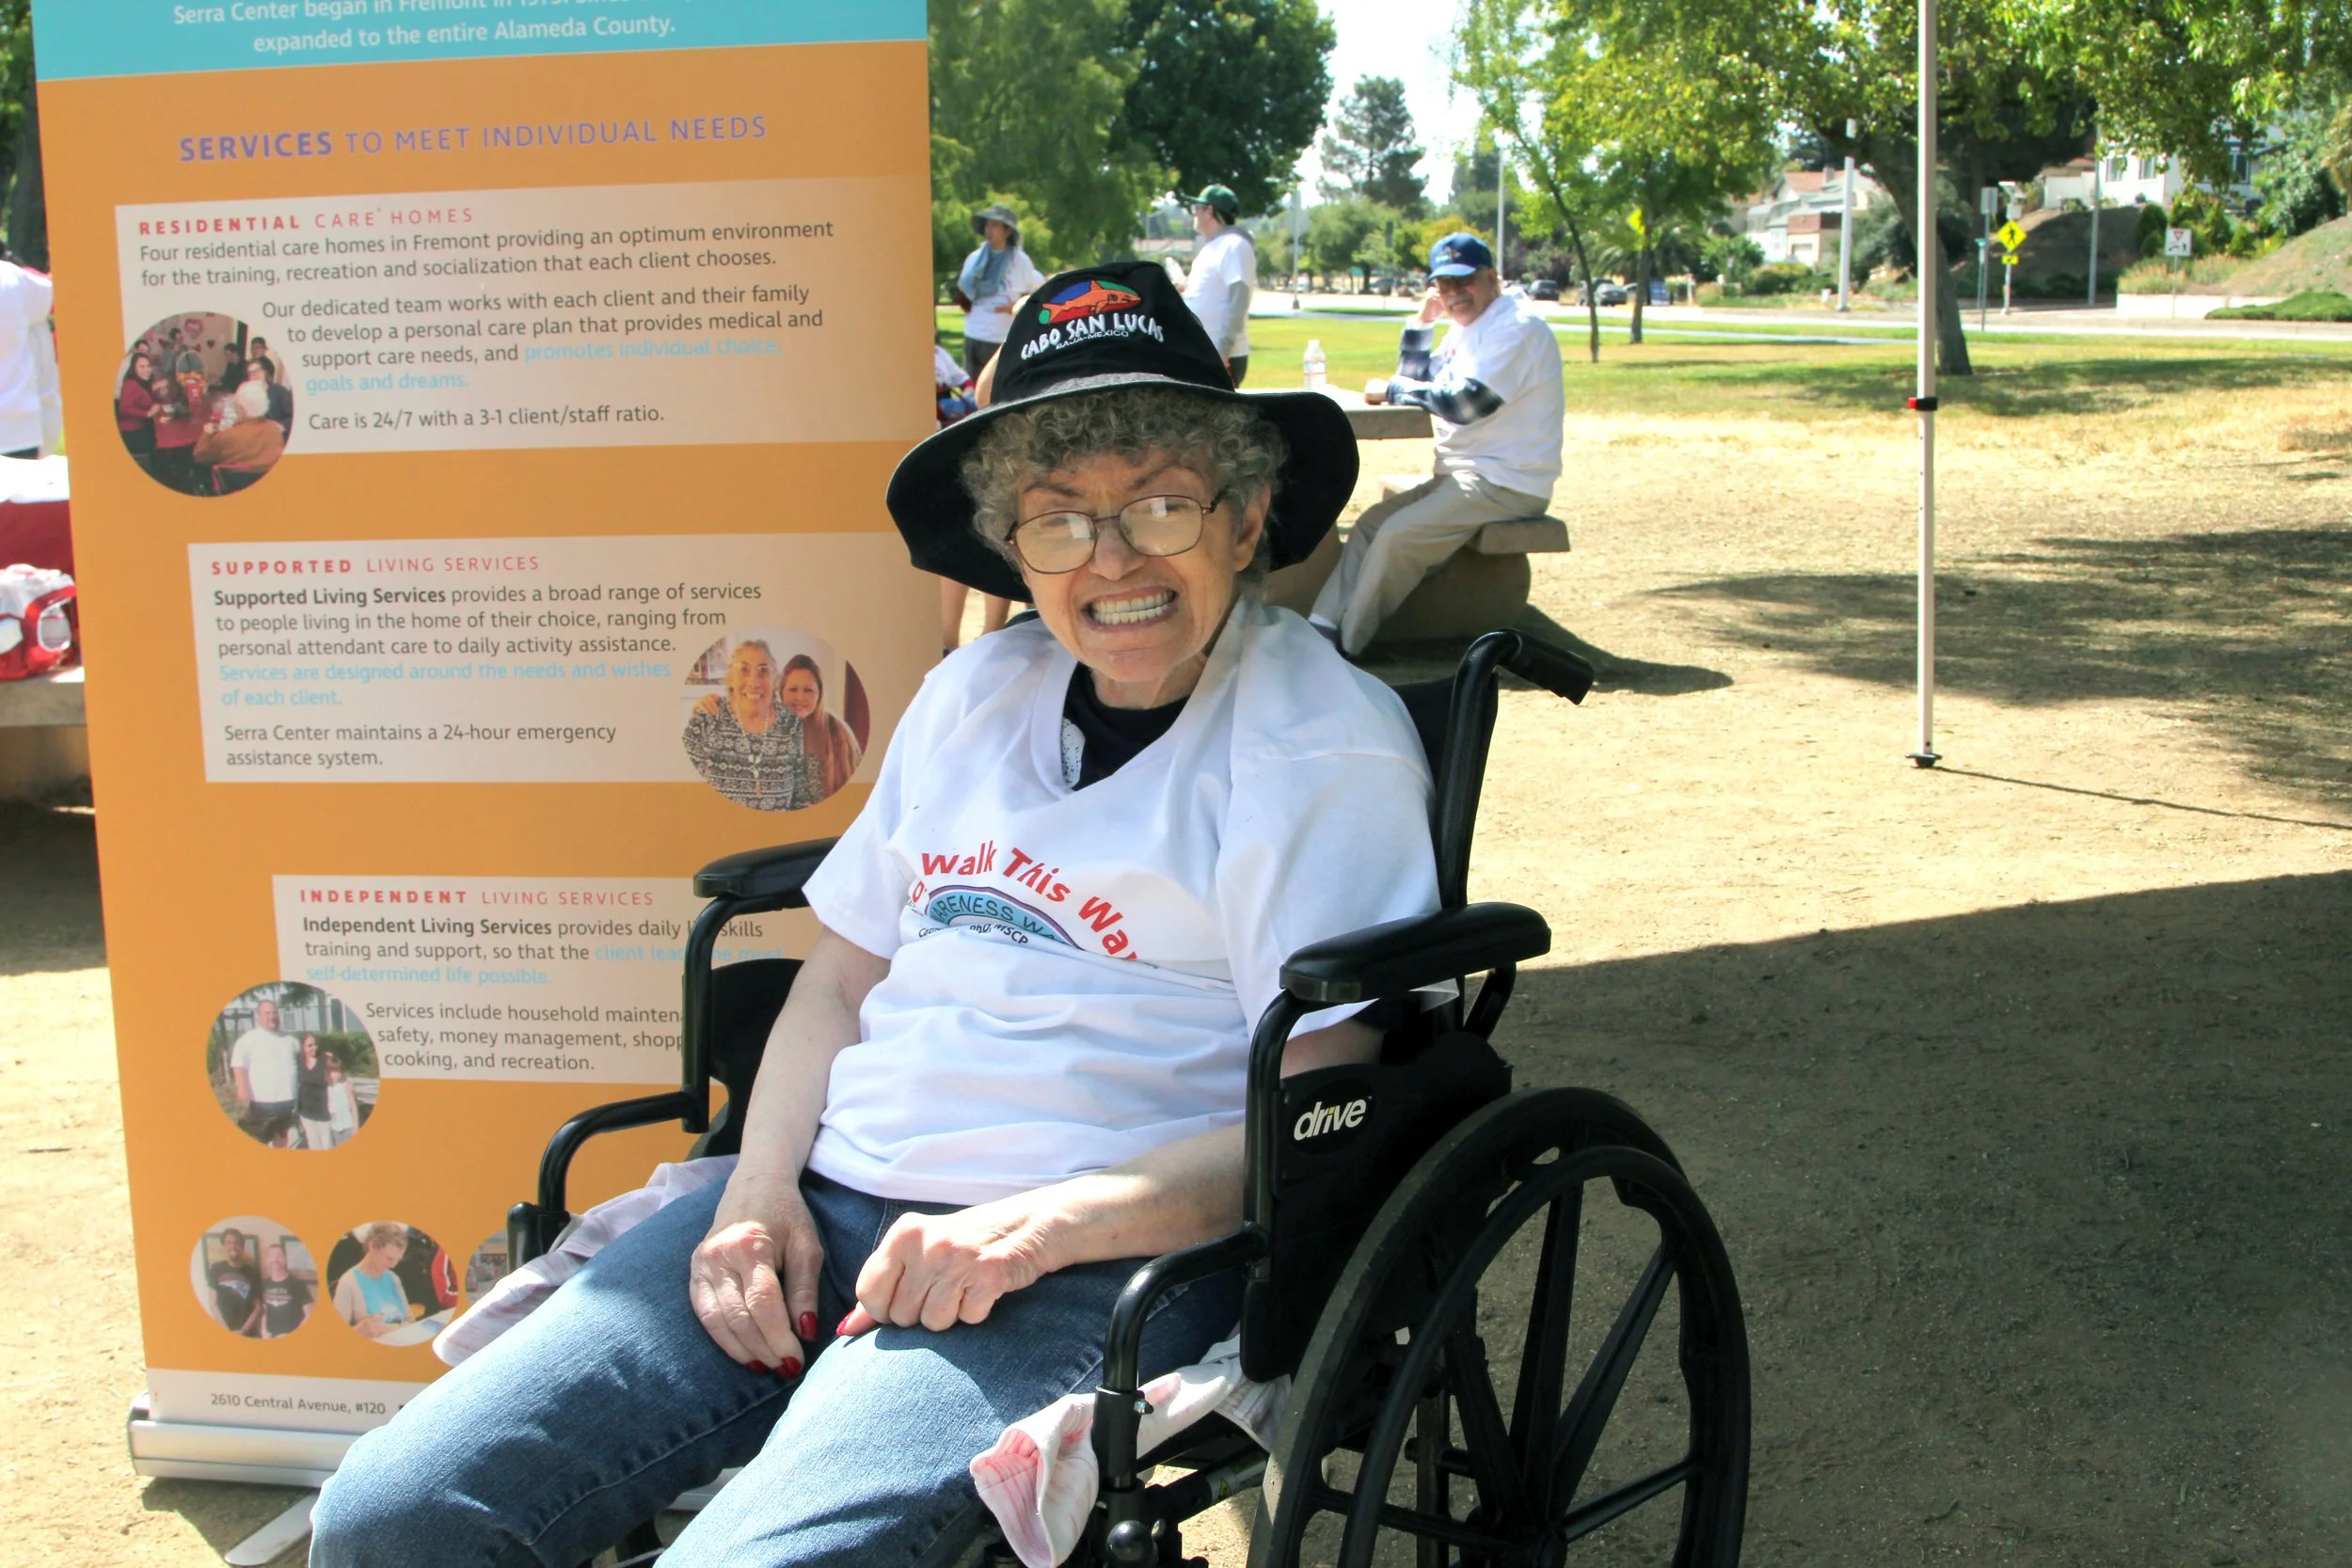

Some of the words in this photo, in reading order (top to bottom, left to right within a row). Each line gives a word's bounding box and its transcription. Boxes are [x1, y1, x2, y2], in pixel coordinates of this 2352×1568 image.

[173, 6, 226, 24] Serra
[231, 2, 299, 21] Center
[305, 0, 368, 20] began
[374, 0, 393, 12] in
[254, 28, 352, 55] expanded
[358, 29, 380, 46] to
[387, 25, 421, 45] the
[427, 23, 487, 42] entire
[495, 20, 586, 40] Alameda
[594, 17, 675, 38] County.
[180, 130, 332, 163] SERVICES
[345, 131, 382, 154] TO
[395, 126, 469, 151] MEET
[483, 120, 658, 148] INDIVIDUAL
[670, 115, 767, 141] NEEDS
[139, 215, 299, 235] RESIDENTIAL
[315, 213, 373, 228] CARE
[391, 208, 471, 224] HOMES
[140, 245, 179, 261] Four
[185, 240, 276, 260] residential
[282, 243, 319, 256] care
[326, 238, 385, 253] homes
[391, 235, 406, 250] in
[414, 233, 490, 250] Fremont
[497, 230, 583, 251] providing
[591, 231, 612, 245] an
[619, 227, 705, 246] optimum
[712, 222, 834, 240] environment
[142, 270, 166, 286] for
[172, 269, 200, 285] the
[207, 267, 279, 286] training,
[287, 262, 377, 280] recreation
[384, 260, 417, 277] and
[423, 257, 536, 276] socialization
[544, 255, 582, 271] that
[589, 252, 632, 270] each
[639, 251, 690, 268] client
[697, 249, 775, 266] chooses.
[262, 302, 294, 318] Our
[301, 298, 389, 316] dedicated
[396, 299, 441, 313] team
[448, 293, 501, 310] works
[507, 293, 547, 309] with
[554, 291, 596, 308] each
[604, 290, 654, 307] client
[661, 287, 695, 305] and
[702, 287, 745, 304] their
[753, 285, 809, 305] family
[288, 327, 306, 342] to
[311, 324, 382, 343] develop
[389, 326, 398, 339] a
[405, 320, 482, 342] personal
[488, 323, 526, 336] care
[533, 318, 572, 339] plan
[580, 316, 617, 333] that
[625, 313, 702, 336] provides
[709, 310, 781, 329] medical
[788, 309, 822, 327] and
[1021, 328, 1061, 360] CABO
[1066, 313, 1105, 340] SAN
[1114, 312, 1165, 343] LUCAS
[1056, 330, 1129, 350] BAJA-MEXICO
[302, 351, 371, 370] support
[377, 351, 414, 364] care
[421, 346, 477, 364] needs,
[485, 343, 518, 361] and
[309, 414, 348, 430] Care
[355, 413, 367, 428] is
[373, 410, 412, 430] 24/7
[419, 410, 457, 426] with
[464, 414, 473, 425] a
[481, 409, 501, 425] 3-1
[509, 405, 610, 426] client/staff
[616, 405, 663, 421] ratio.
[212, 560, 351, 575] SUPPORTED
[367, 558, 433, 572] LIVING
[445, 557, 538, 571] SERVICES
[215, 589, 307, 609] Supported
[313, 588, 367, 608] Living
[373, 587, 446, 603] Services
[452, 586, 526, 606] provides
[532, 590, 542, 601] a
[549, 584, 601, 601] broad
[609, 588, 660, 604] range
[666, 582, 684, 599] of
[691, 583, 761, 599] services
[216, 617, 234, 631] to
[241, 614, 297, 634] people
[303, 614, 349, 633] living
[356, 613, 371, 628] in
[377, 613, 405, 628] the
[412, 612, 461, 628] home
[468, 611, 485, 627] of
[491, 611, 532, 627] their
[538, 610, 600, 628] choice,
[608, 610, 675, 630] ranging
[683, 609, 725, 625] from
[218, 640, 292, 658] personal
[297, 639, 385, 655] attendant
[391, 641, 427, 654] care
[433, 640, 452, 654] to
[458, 637, 500, 657] daily
[507, 637, 572, 657] activity
[580, 636, 675, 652] assistance.
[225, 725, 267, 740] Serra
[273, 725, 329, 740] Center
[336, 724, 421, 740] maintains
[428, 728, 437, 739] a
[444, 723, 511, 739] 24-hour
[517, 727, 616, 743] emergency
[227, 750, 311, 766] assistance
[318, 751, 382, 769] system.
[921, 840, 997, 876] Walk
[1003, 847, 1071, 903] This
[301, 890, 466, 903] INDEPENDENT
[483, 892, 547, 904] LIVING
[559, 892, 652, 905] SERVICES
[304, 917, 416, 936] Independent
[421, 918, 474, 937] Living
[481, 919, 551, 934] Services
[559, 920, 632, 938] provides
[639, 920, 680, 940] daily
[306, 942, 371, 960] training
[377, 942, 408, 958] and
[415, 944, 486, 961] support,
[493, 947, 512, 958] so
[517, 943, 554, 959] that
[561, 944, 589, 959] the
[366, 1003, 434, 1019] Services
[440, 1004, 501, 1020] include
[508, 1005, 598, 1022] household
[378, 1026, 433, 1046] safety,
[440, 1032, 498, 1048] money
[504, 1033, 627, 1049] management,
[633, 1031, 684, 1051] shopp
[385, 1051, 457, 1070] cooking,
[464, 1053, 495, 1068] and
[501, 1054, 594, 1069] recreation.
[1294, 1099, 1367, 1141] drive
[212, 1393, 240, 1406] 2610
[245, 1396, 293, 1409] Central
[298, 1399, 351, 1414] Avenue,
[356, 1402, 386, 1415] #120
